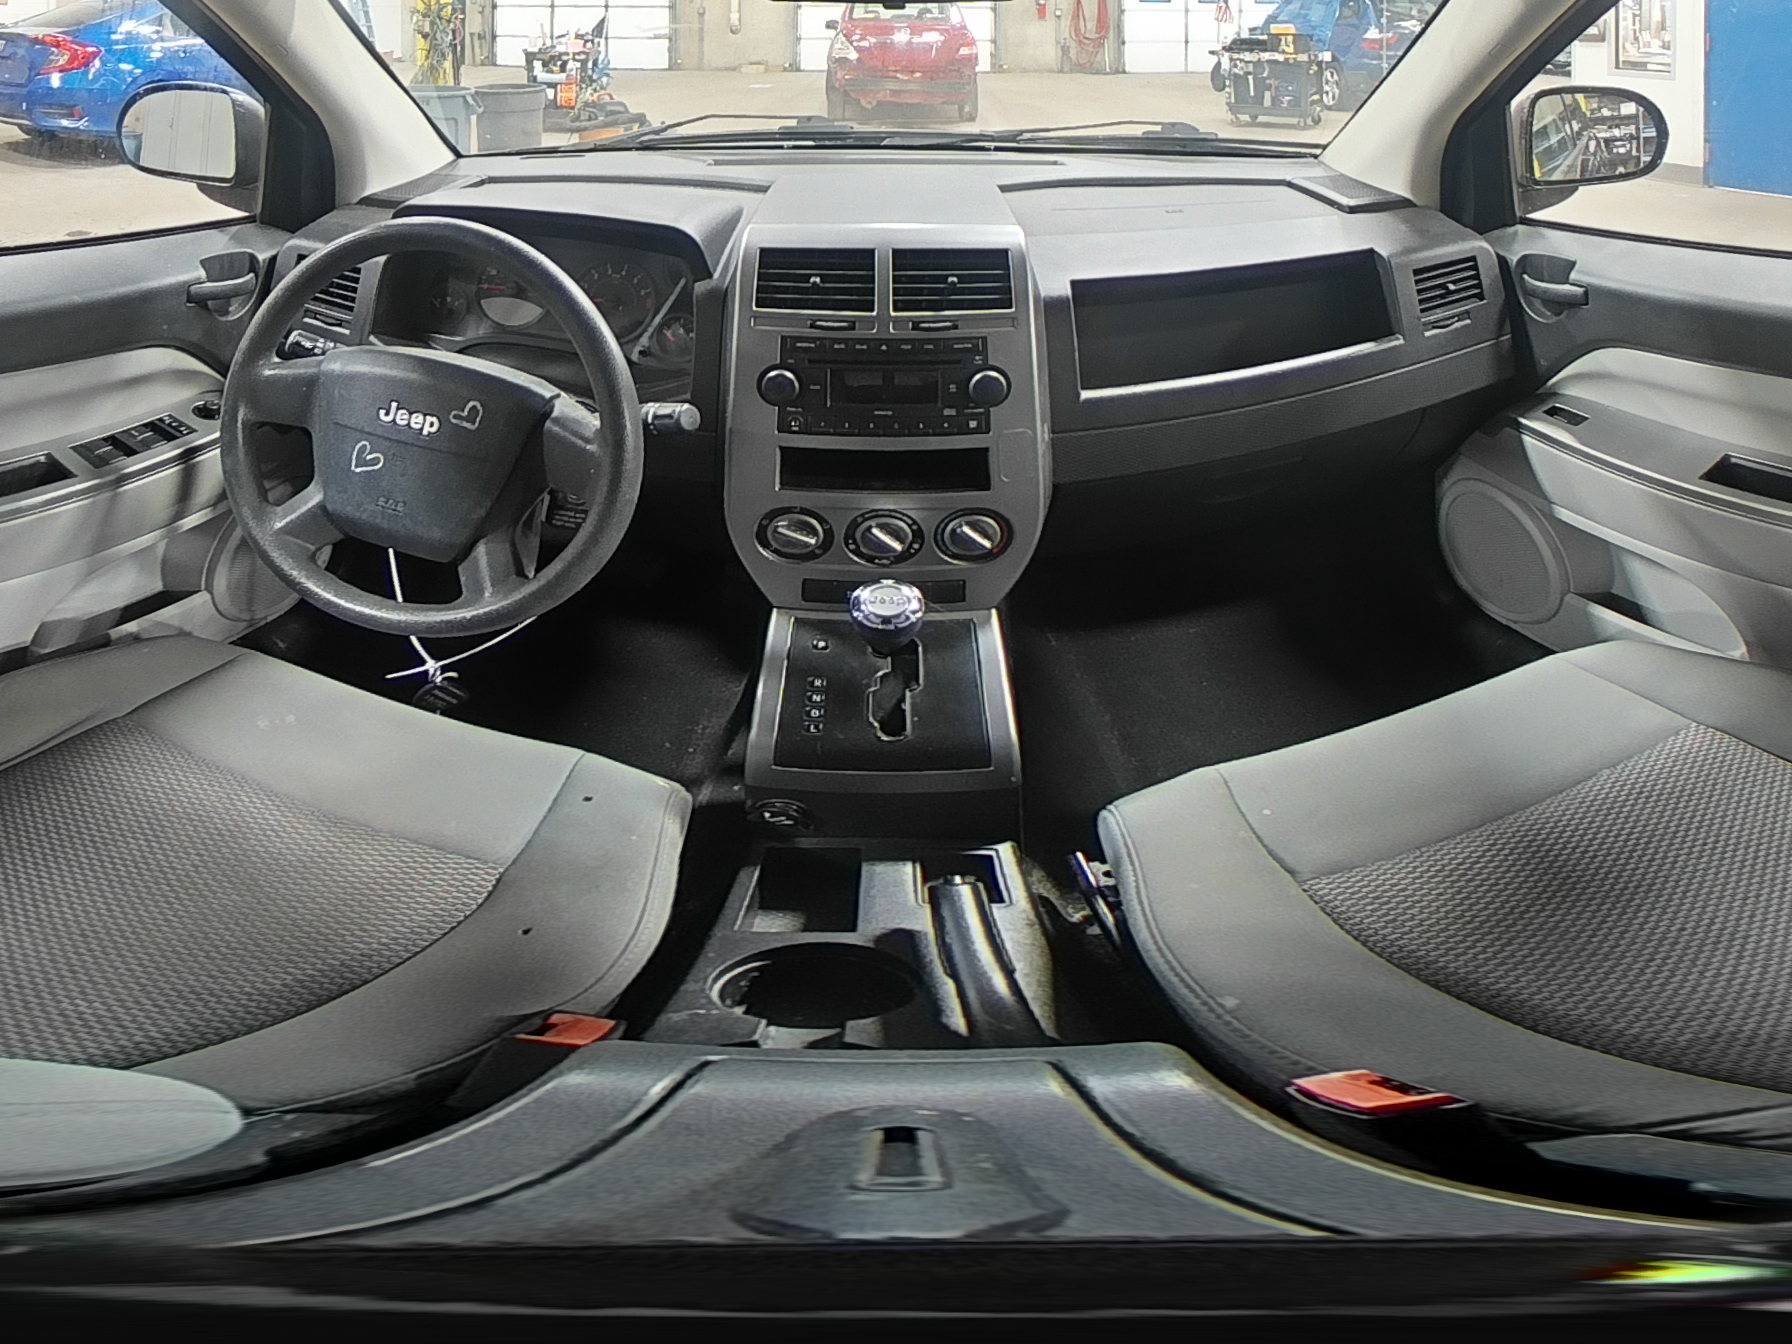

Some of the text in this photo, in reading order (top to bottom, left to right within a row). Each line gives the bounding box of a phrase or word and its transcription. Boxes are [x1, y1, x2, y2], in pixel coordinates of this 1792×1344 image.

[379, 401, 441, 436] Jeep
[817, 640, 827, 649] P
[814, 679, 822, 688] R
[813, 694, 822, 702] N
[810, 724, 818, 733] L
